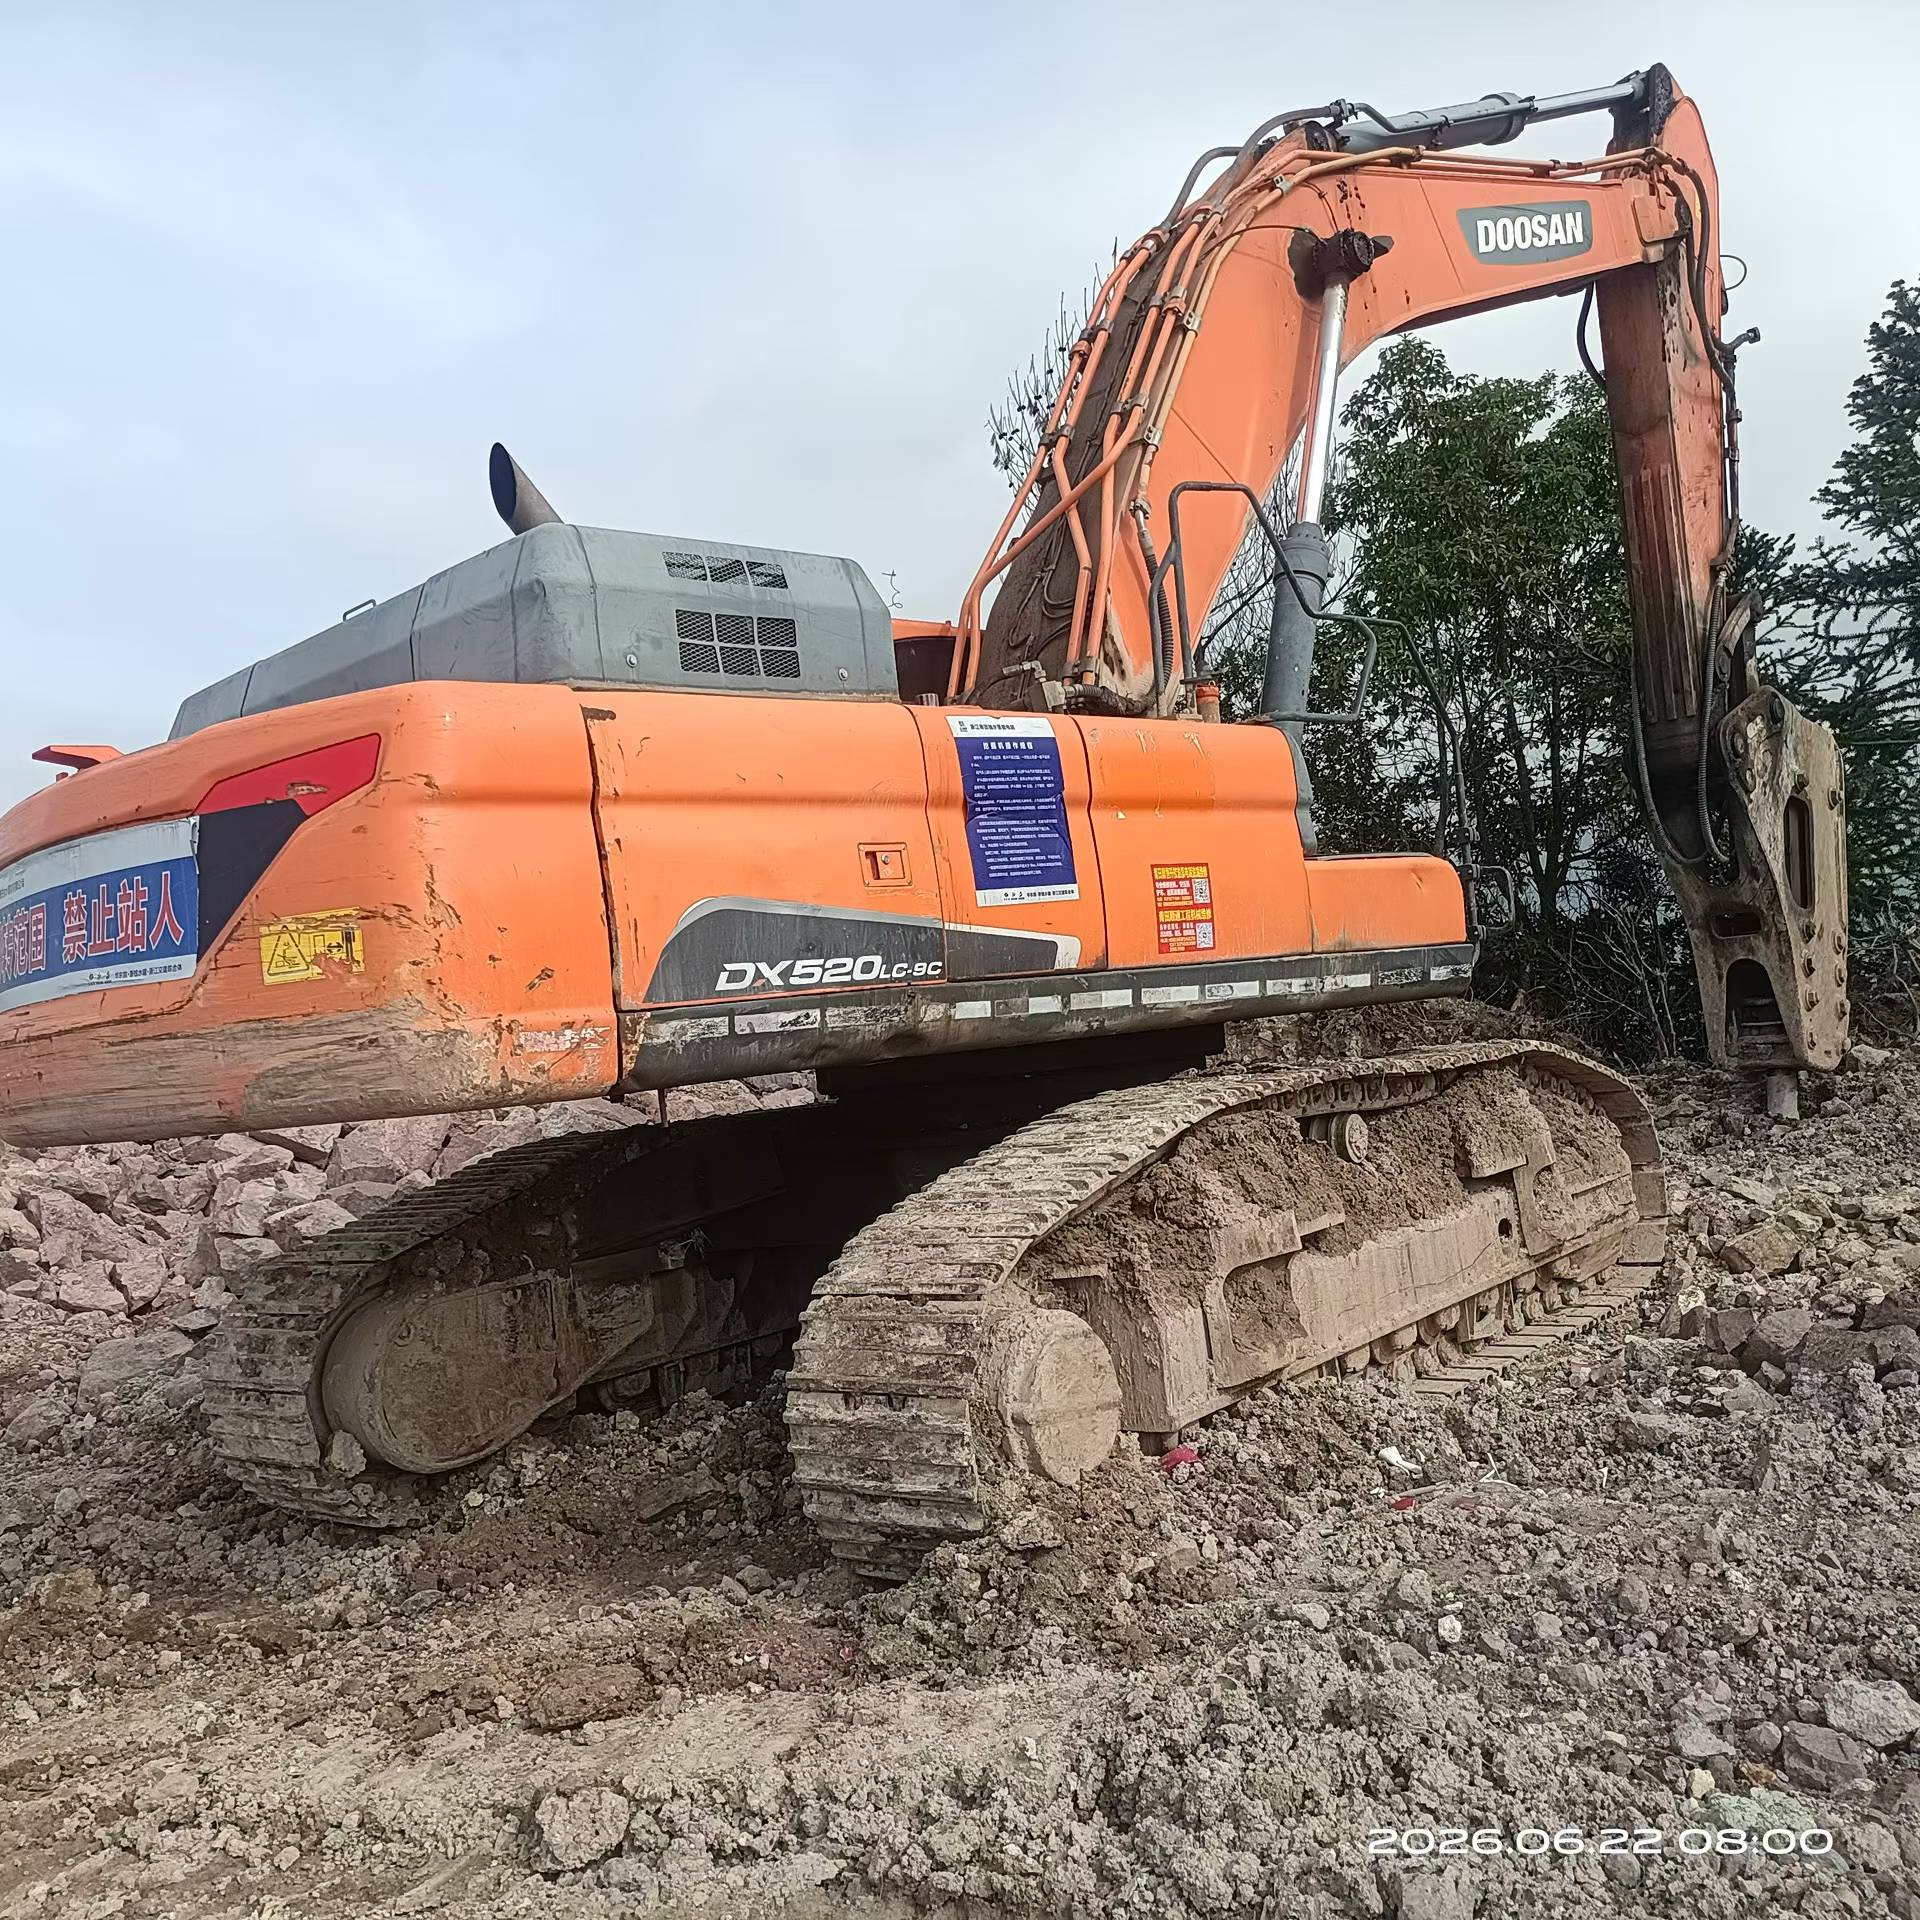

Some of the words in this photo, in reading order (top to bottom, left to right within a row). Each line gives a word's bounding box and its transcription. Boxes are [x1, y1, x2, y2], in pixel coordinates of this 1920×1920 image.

[1476, 211, 1584, 254] DOOSAN
[62, 870, 185, 965] 禁止站人
